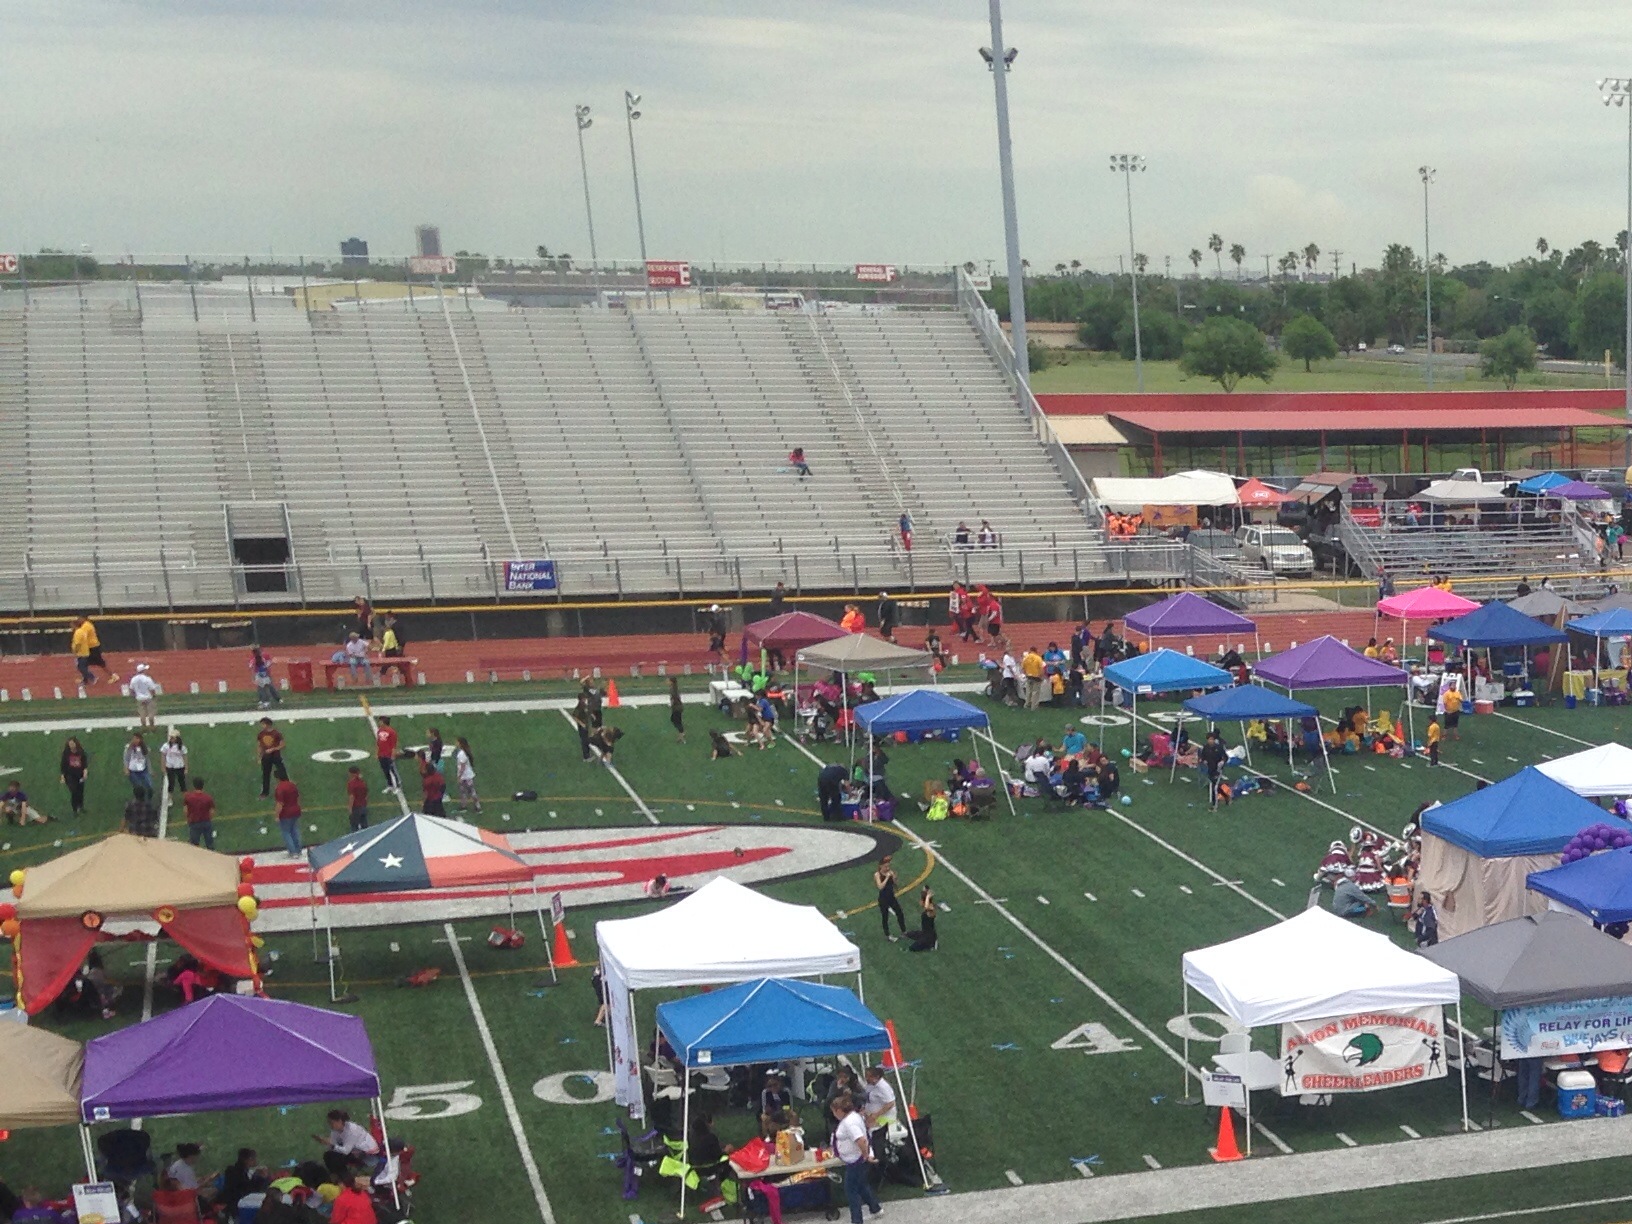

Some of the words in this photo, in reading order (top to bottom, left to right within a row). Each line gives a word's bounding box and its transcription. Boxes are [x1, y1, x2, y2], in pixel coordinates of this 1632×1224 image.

[679, 263, 691, 285] E
[886, 266, 896, 281] F
[508, 581, 535, 590] BANK
[509, 571, 553, 580] NATIONAL
[1340, 1012, 1439, 1038] MEMORIAL
[1539, 1020, 1581, 1033] RELAY
[1584, 1018, 1611, 1030] FOR
[1050, 1022, 1142, 1055] 4
[1587, 1028, 1618, 1051] JAYS
[1301, 1063, 1425, 1090] CHEERLEADERS
[384, 1080, 483, 1121] 5
